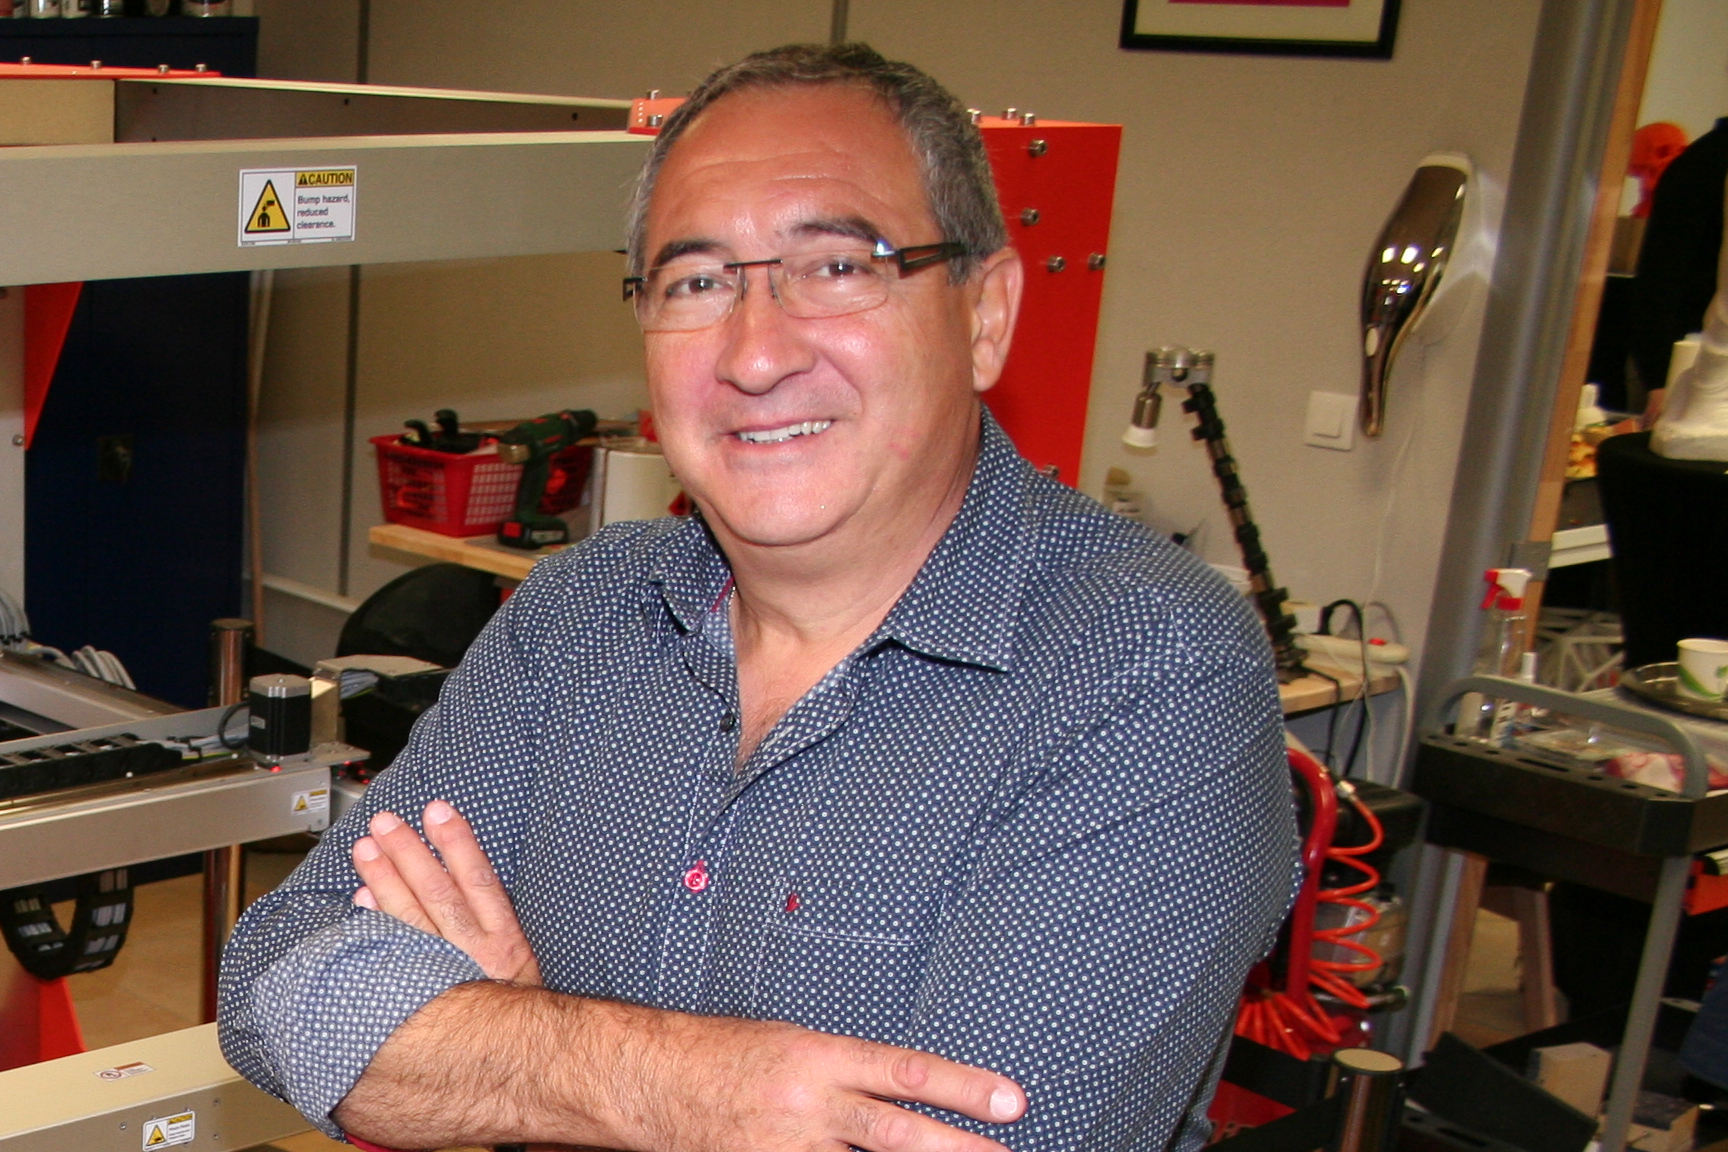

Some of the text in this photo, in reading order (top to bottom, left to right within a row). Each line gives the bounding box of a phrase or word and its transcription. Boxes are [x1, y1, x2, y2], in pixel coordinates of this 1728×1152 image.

[308, 172, 352, 185] CAUTION
[297, 194, 351, 205] Bump hazard,
[297, 207, 329, 217] reduced
[296, 221, 336, 230] clearance.
